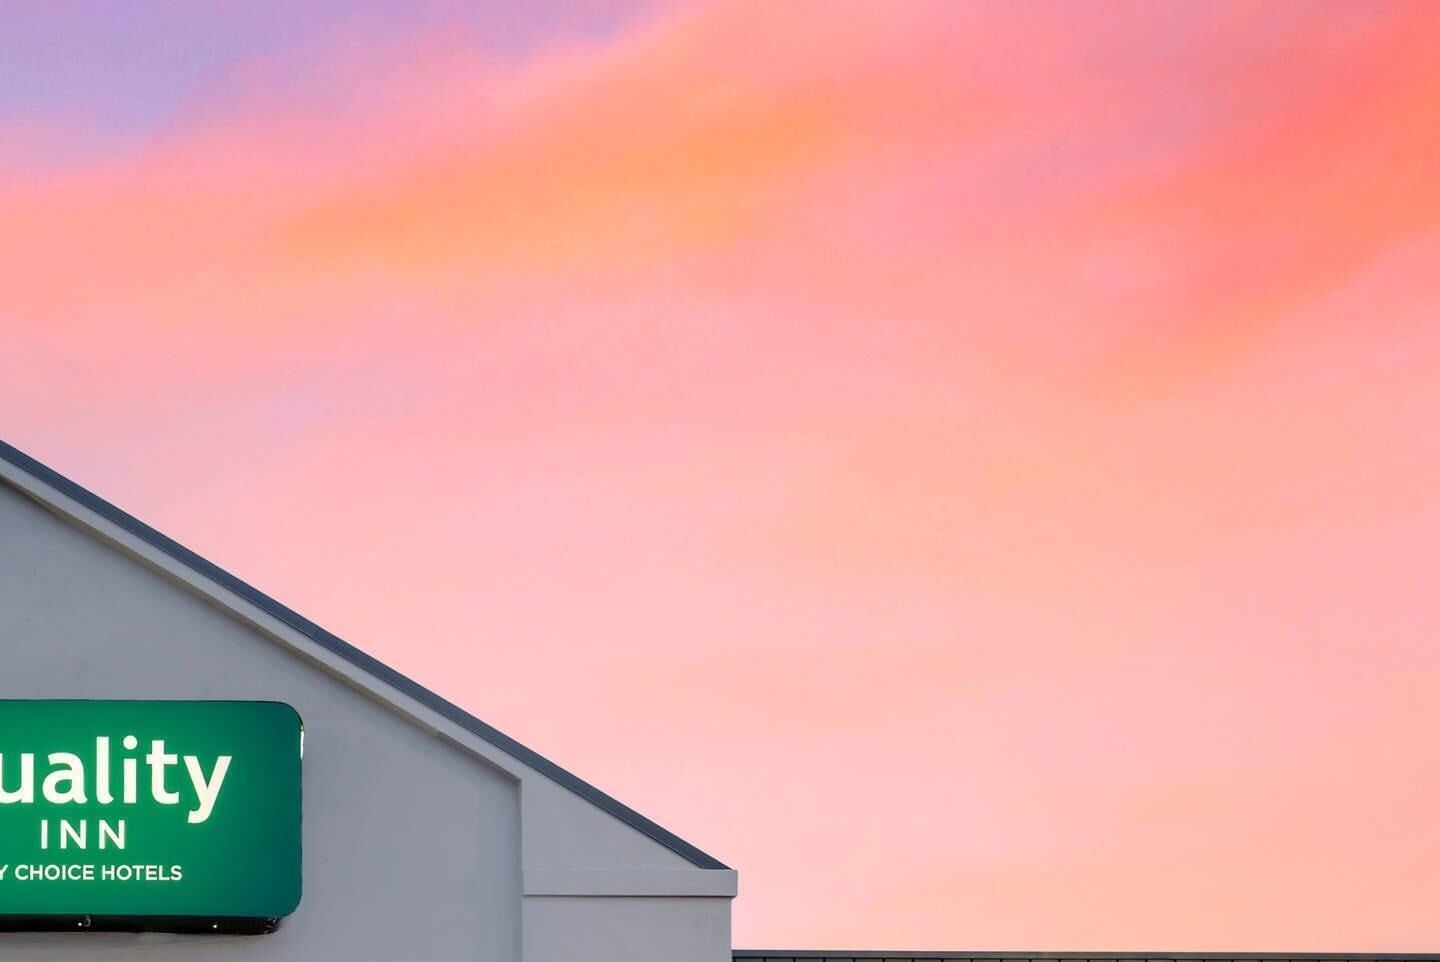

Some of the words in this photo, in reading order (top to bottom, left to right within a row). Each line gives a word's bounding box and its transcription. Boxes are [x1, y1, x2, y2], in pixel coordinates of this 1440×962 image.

[40, 819, 127, 850] INN
[14, 864, 95, 881] CHOICE
[101, 864, 183, 881] HOTELS
